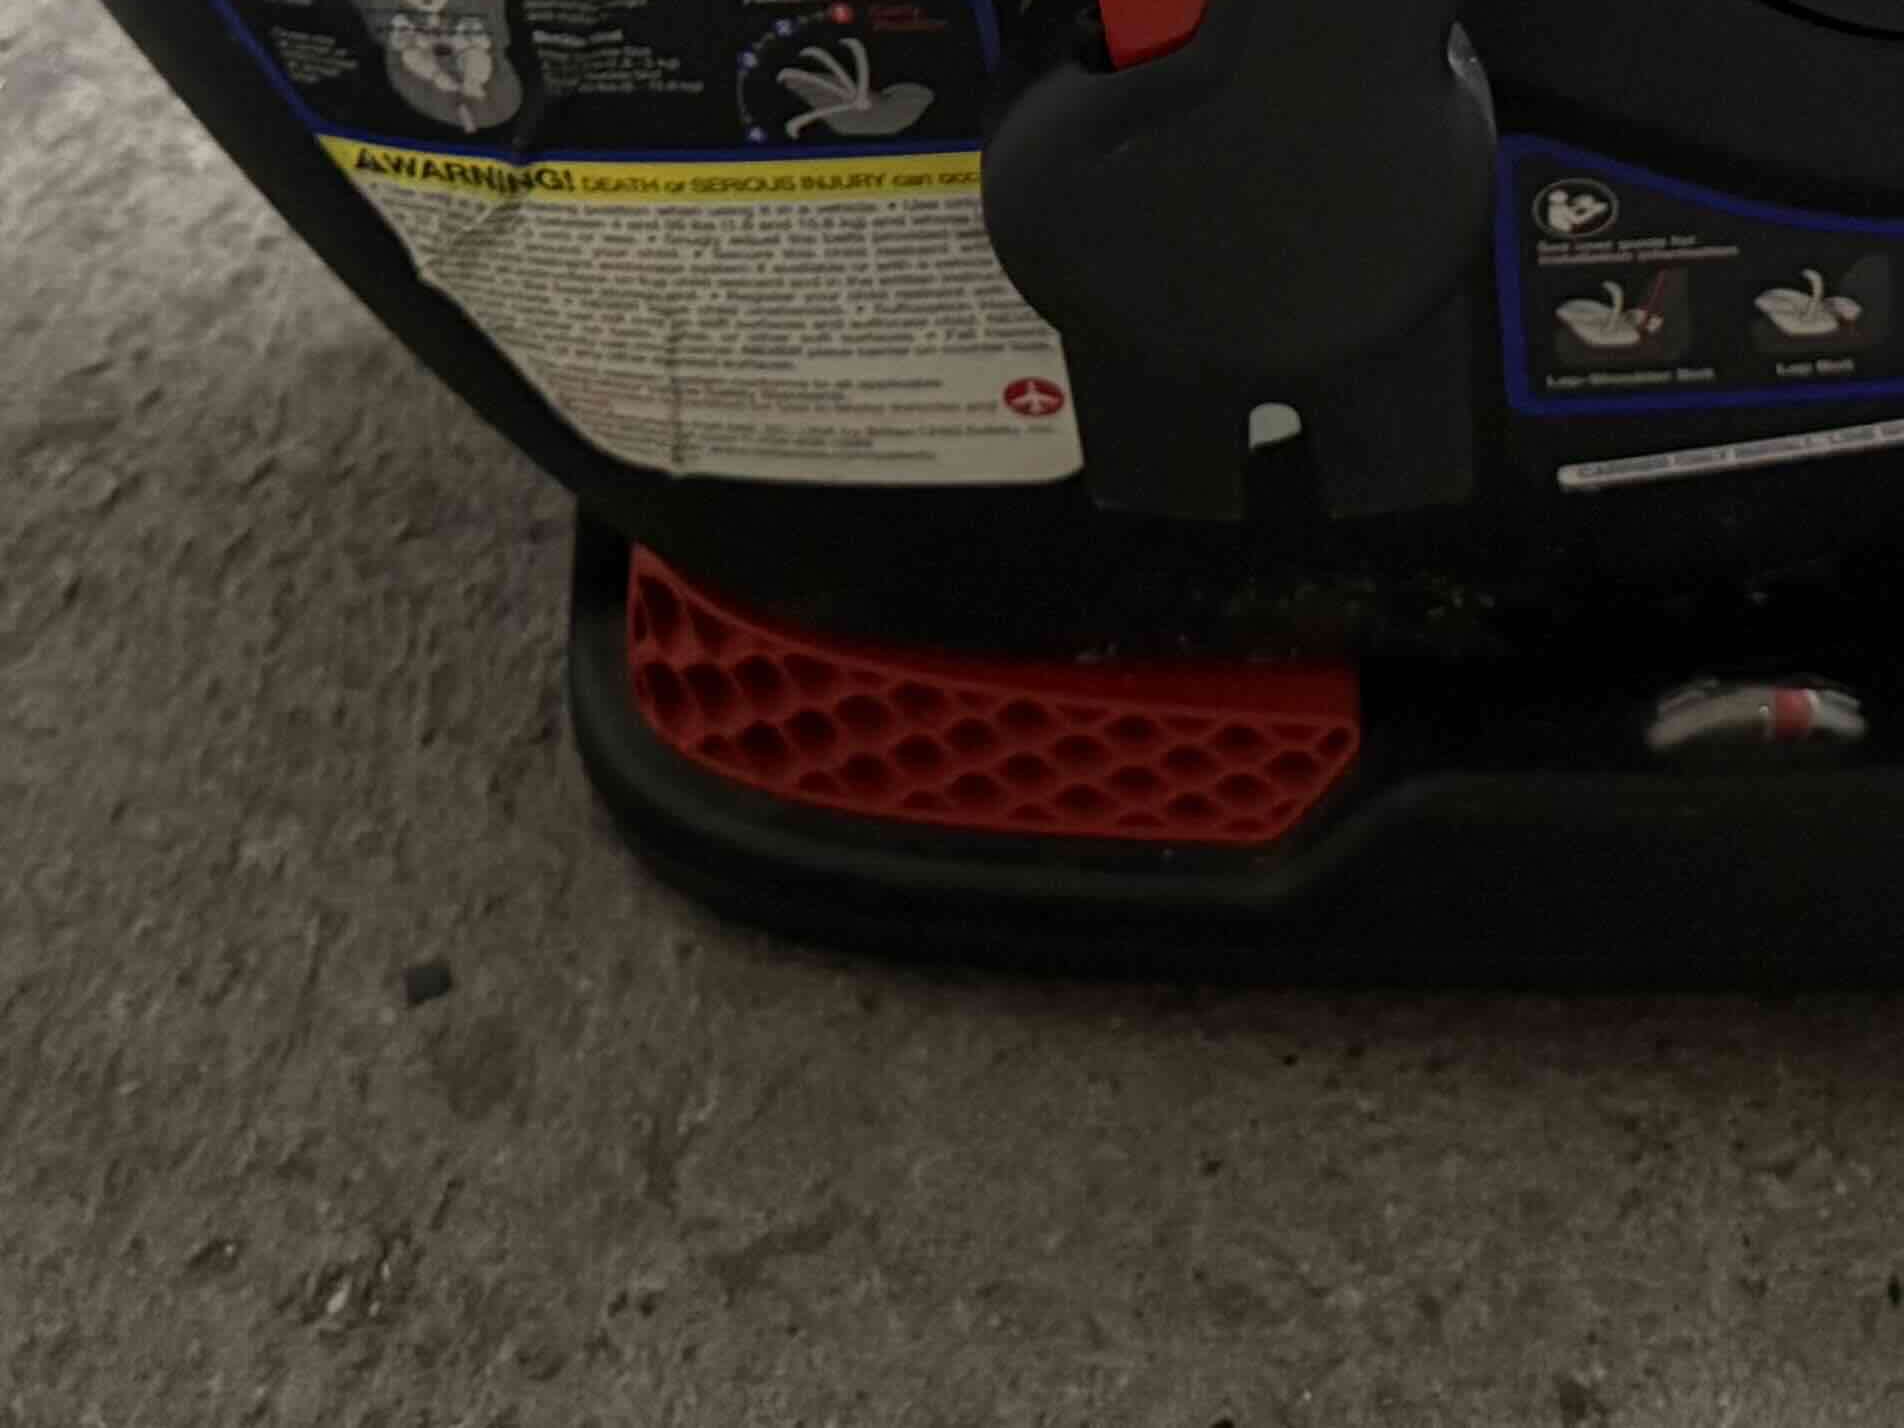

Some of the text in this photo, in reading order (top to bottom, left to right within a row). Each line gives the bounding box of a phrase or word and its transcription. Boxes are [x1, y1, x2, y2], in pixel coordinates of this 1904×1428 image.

[382, 151, 576, 194] WARNING!
[581, 175, 658, 193] DEATH
[663, 178, 686, 194] or
[688, 175, 796, 193] SERIOUS
[799, 172, 887, 191] INJURY
